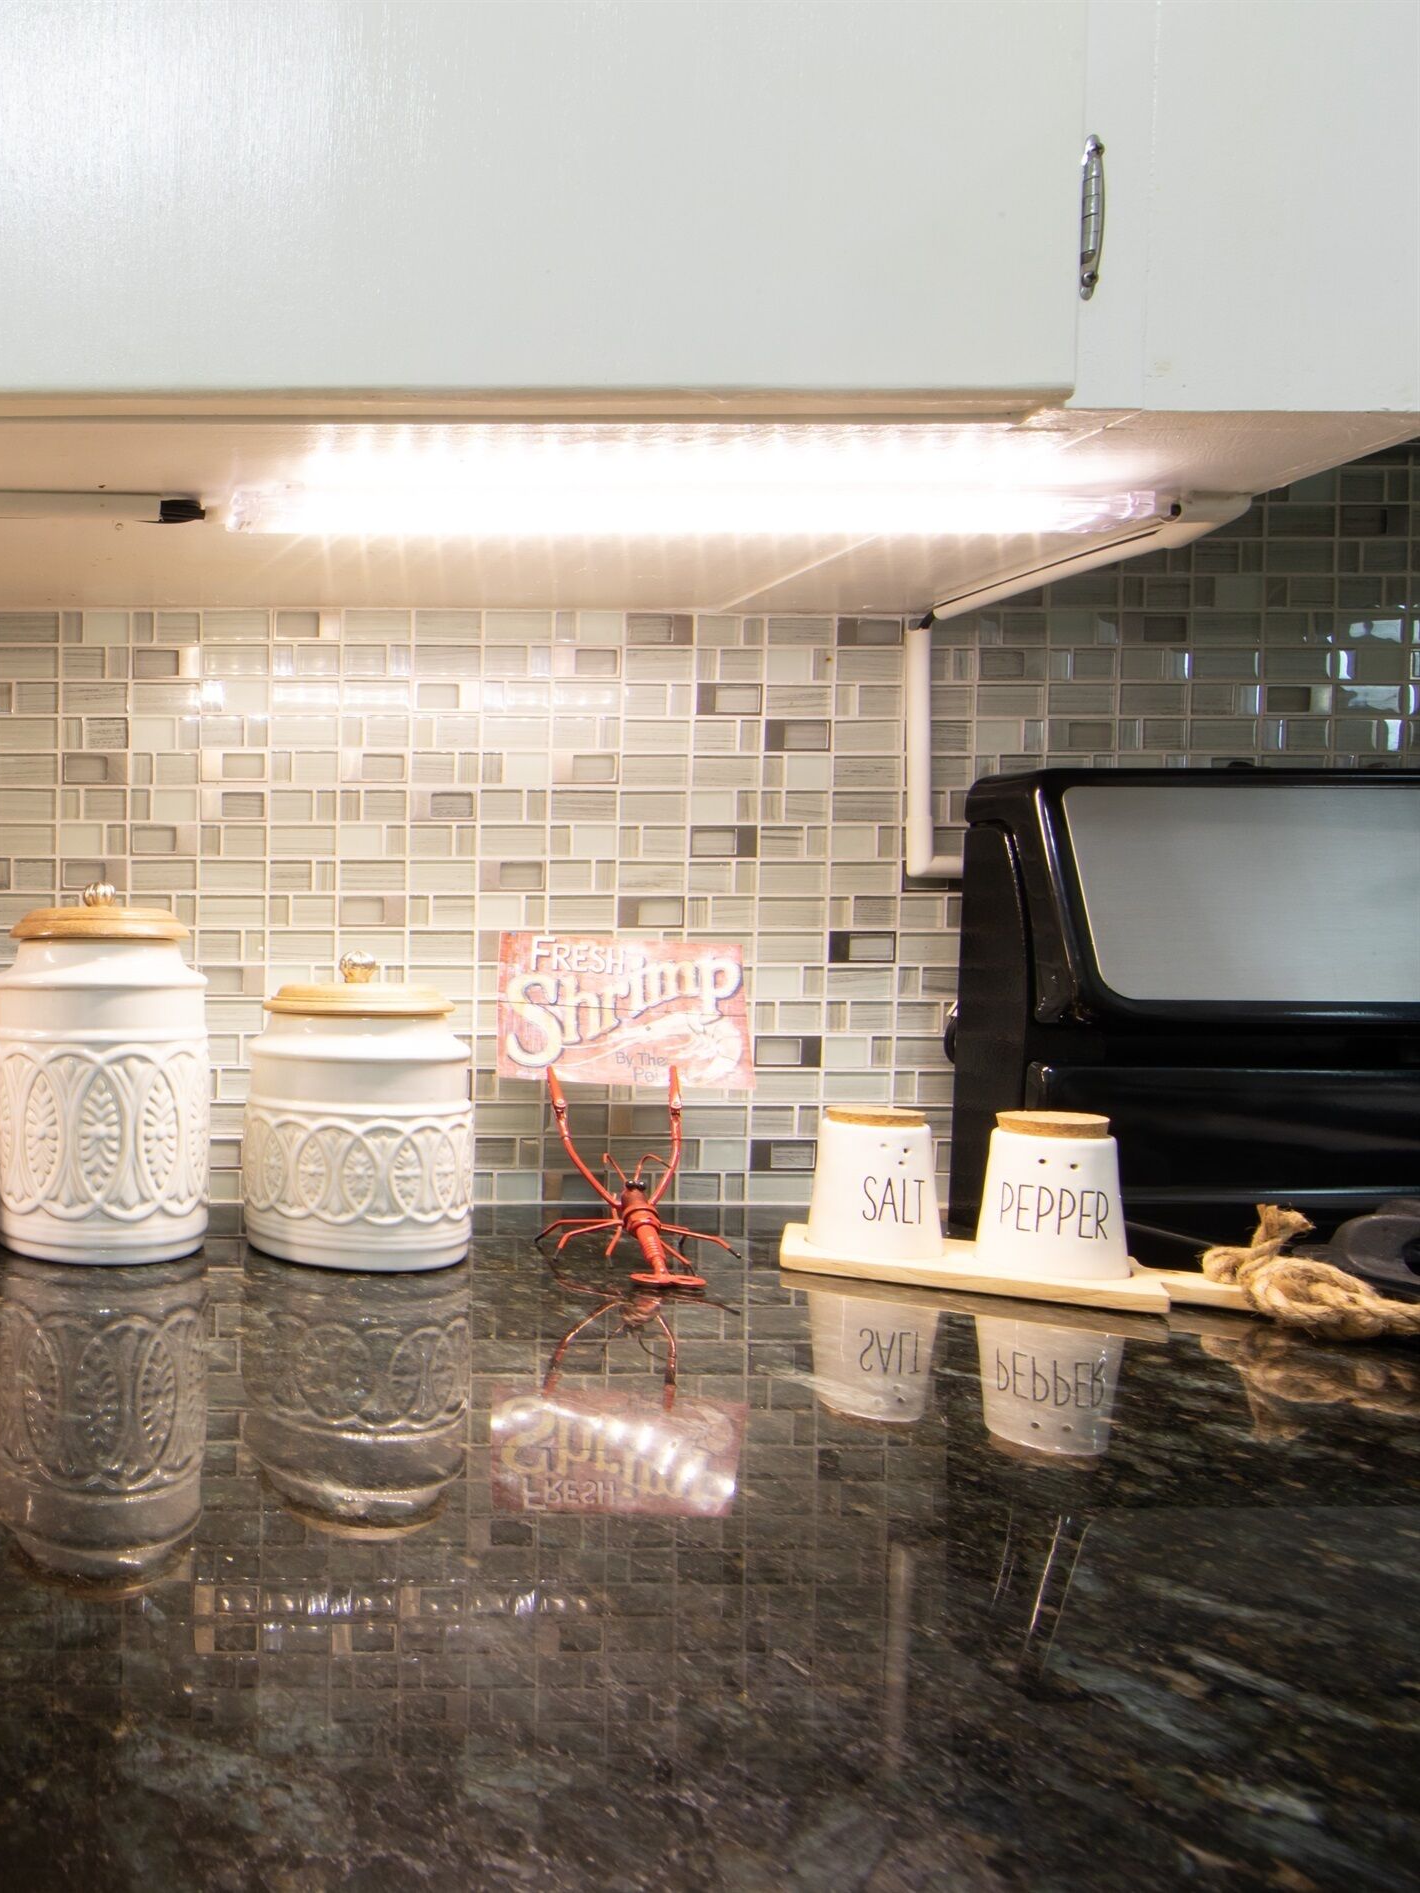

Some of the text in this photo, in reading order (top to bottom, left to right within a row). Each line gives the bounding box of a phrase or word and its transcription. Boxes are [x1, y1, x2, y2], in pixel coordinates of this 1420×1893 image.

[529, 935, 625, 975] FRESH
[506, 956, 743, 1067] Shrimp
[861, 1176, 925, 1225] SALT
[999, 1182, 1109, 1240] PEPPER
